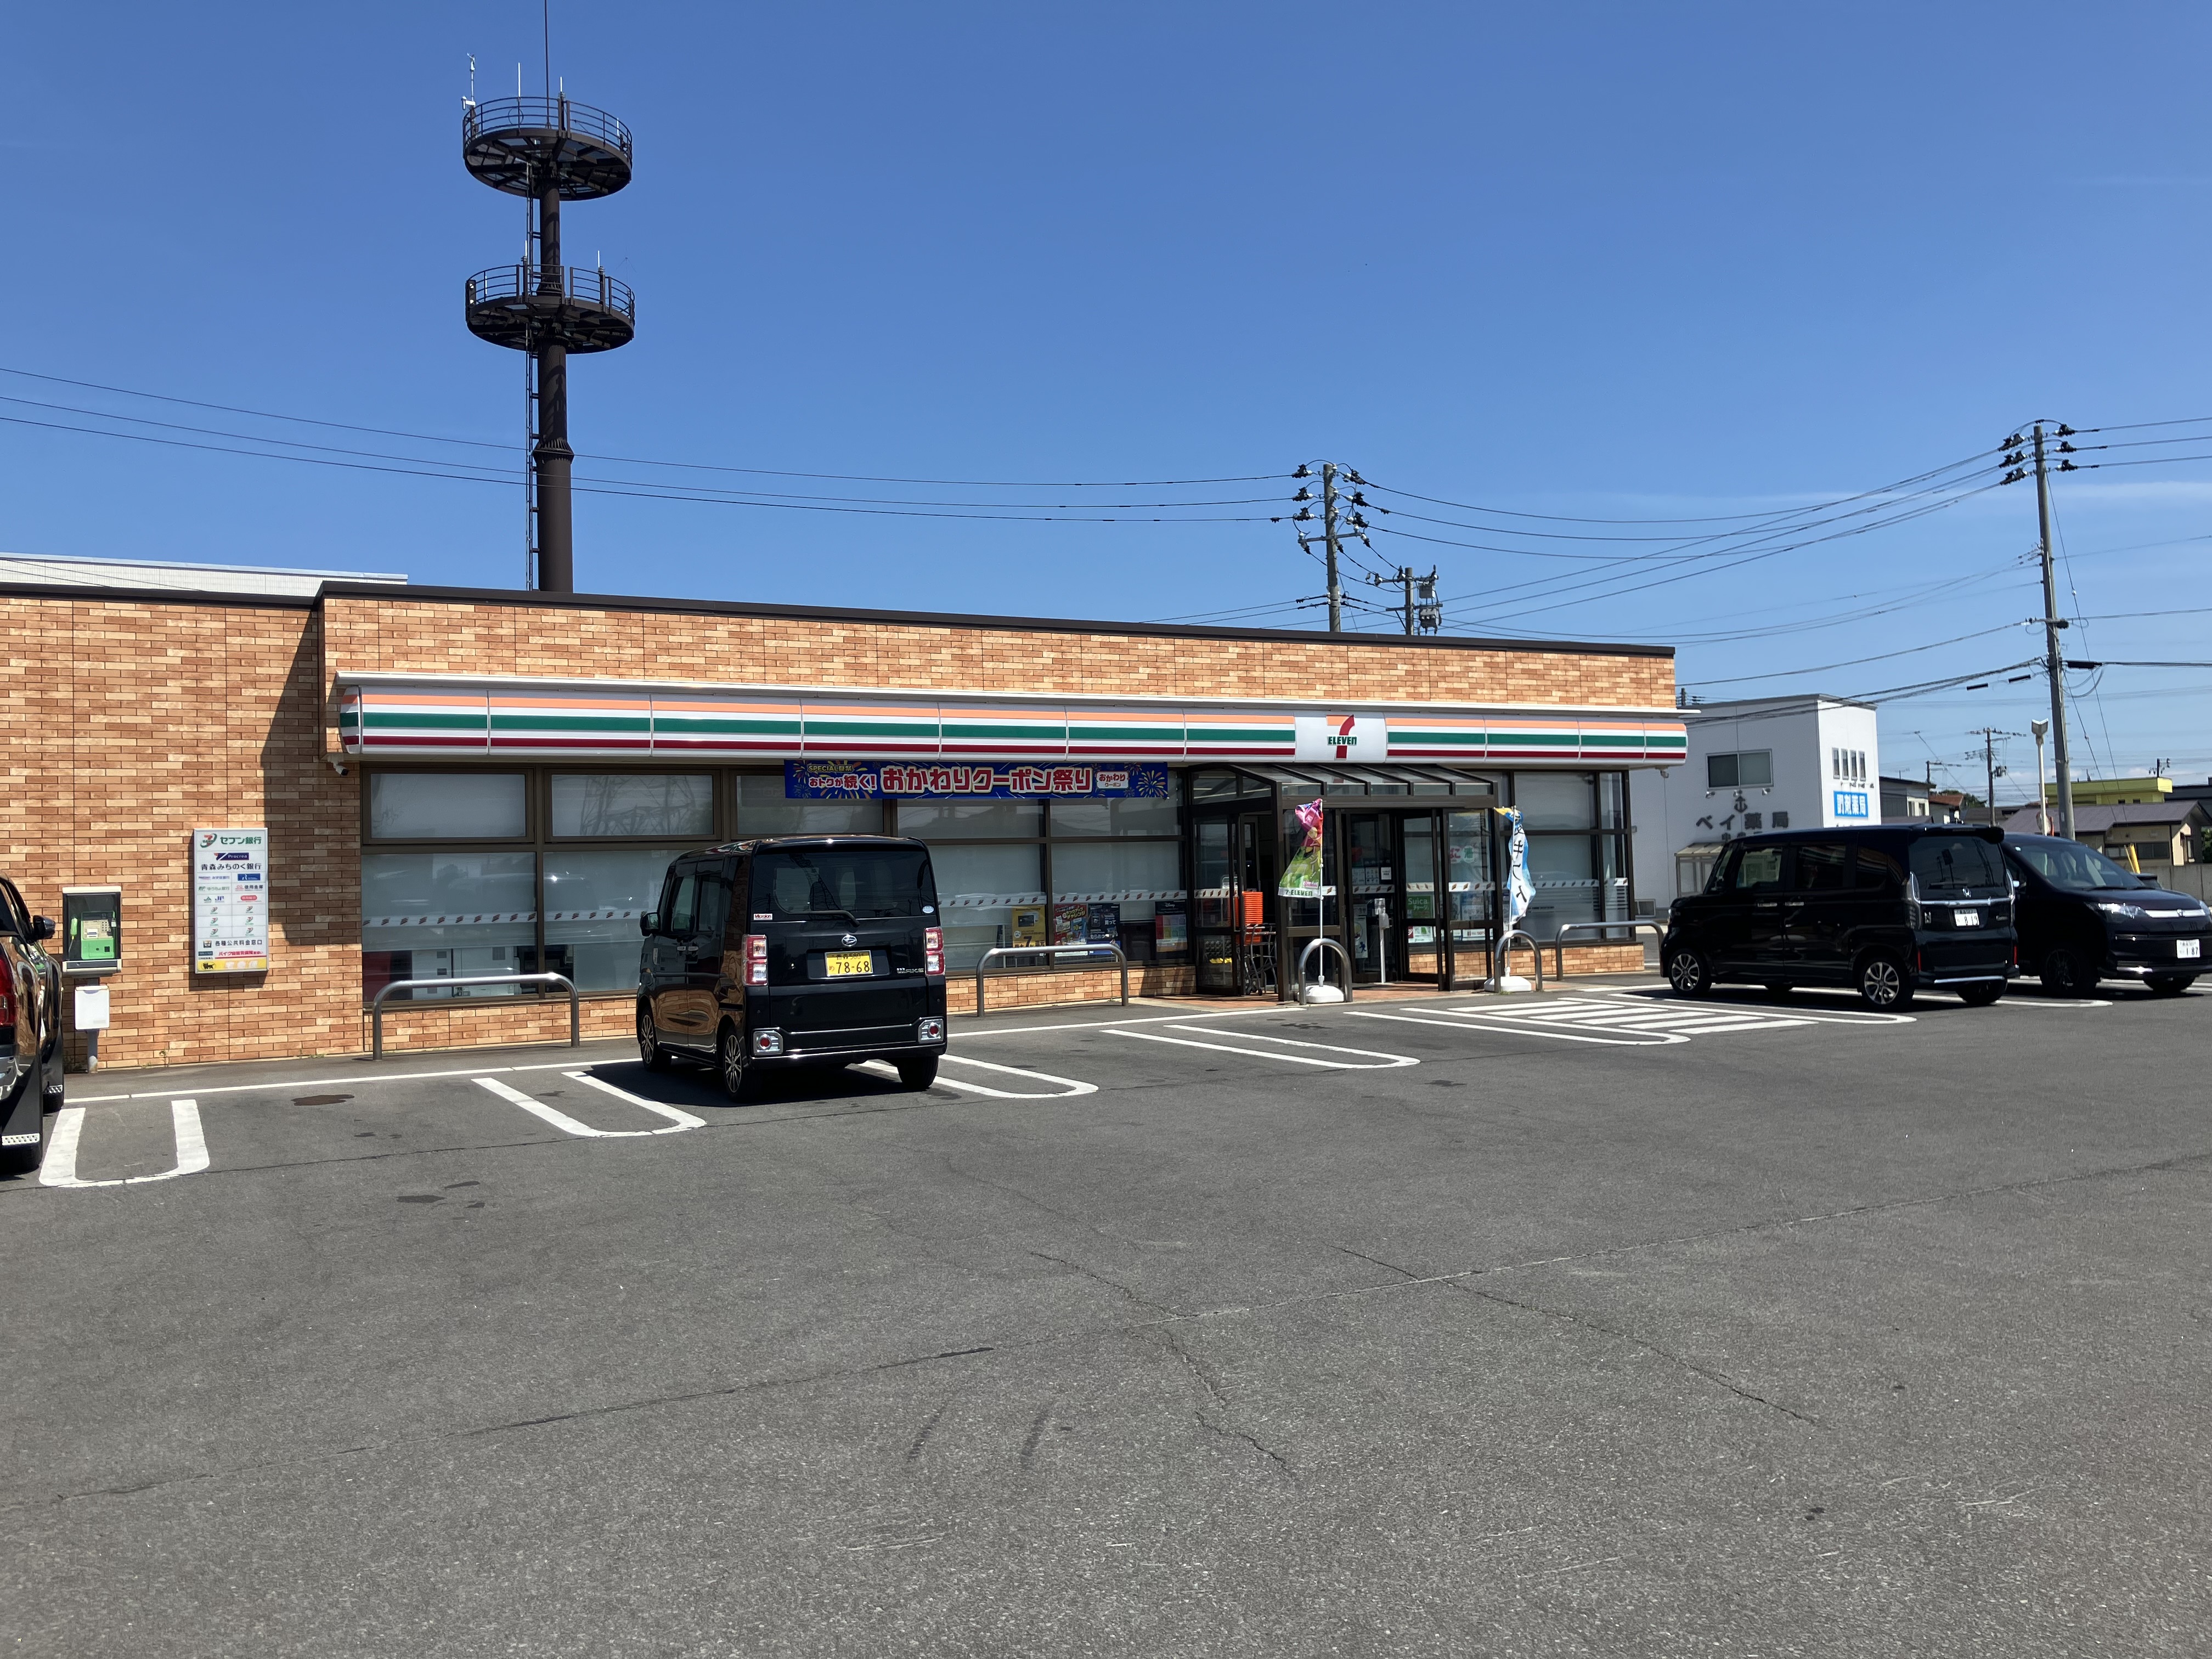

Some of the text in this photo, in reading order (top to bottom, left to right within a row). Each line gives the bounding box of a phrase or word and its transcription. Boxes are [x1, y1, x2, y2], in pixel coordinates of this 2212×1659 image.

[881, 766, 1093, 793] おかわりクーポン祭り
[1099, 773, 1126, 782] おかわり
[220, 836, 262, 845] セブン銀行
[836, 961, 870, 974] 78-68
